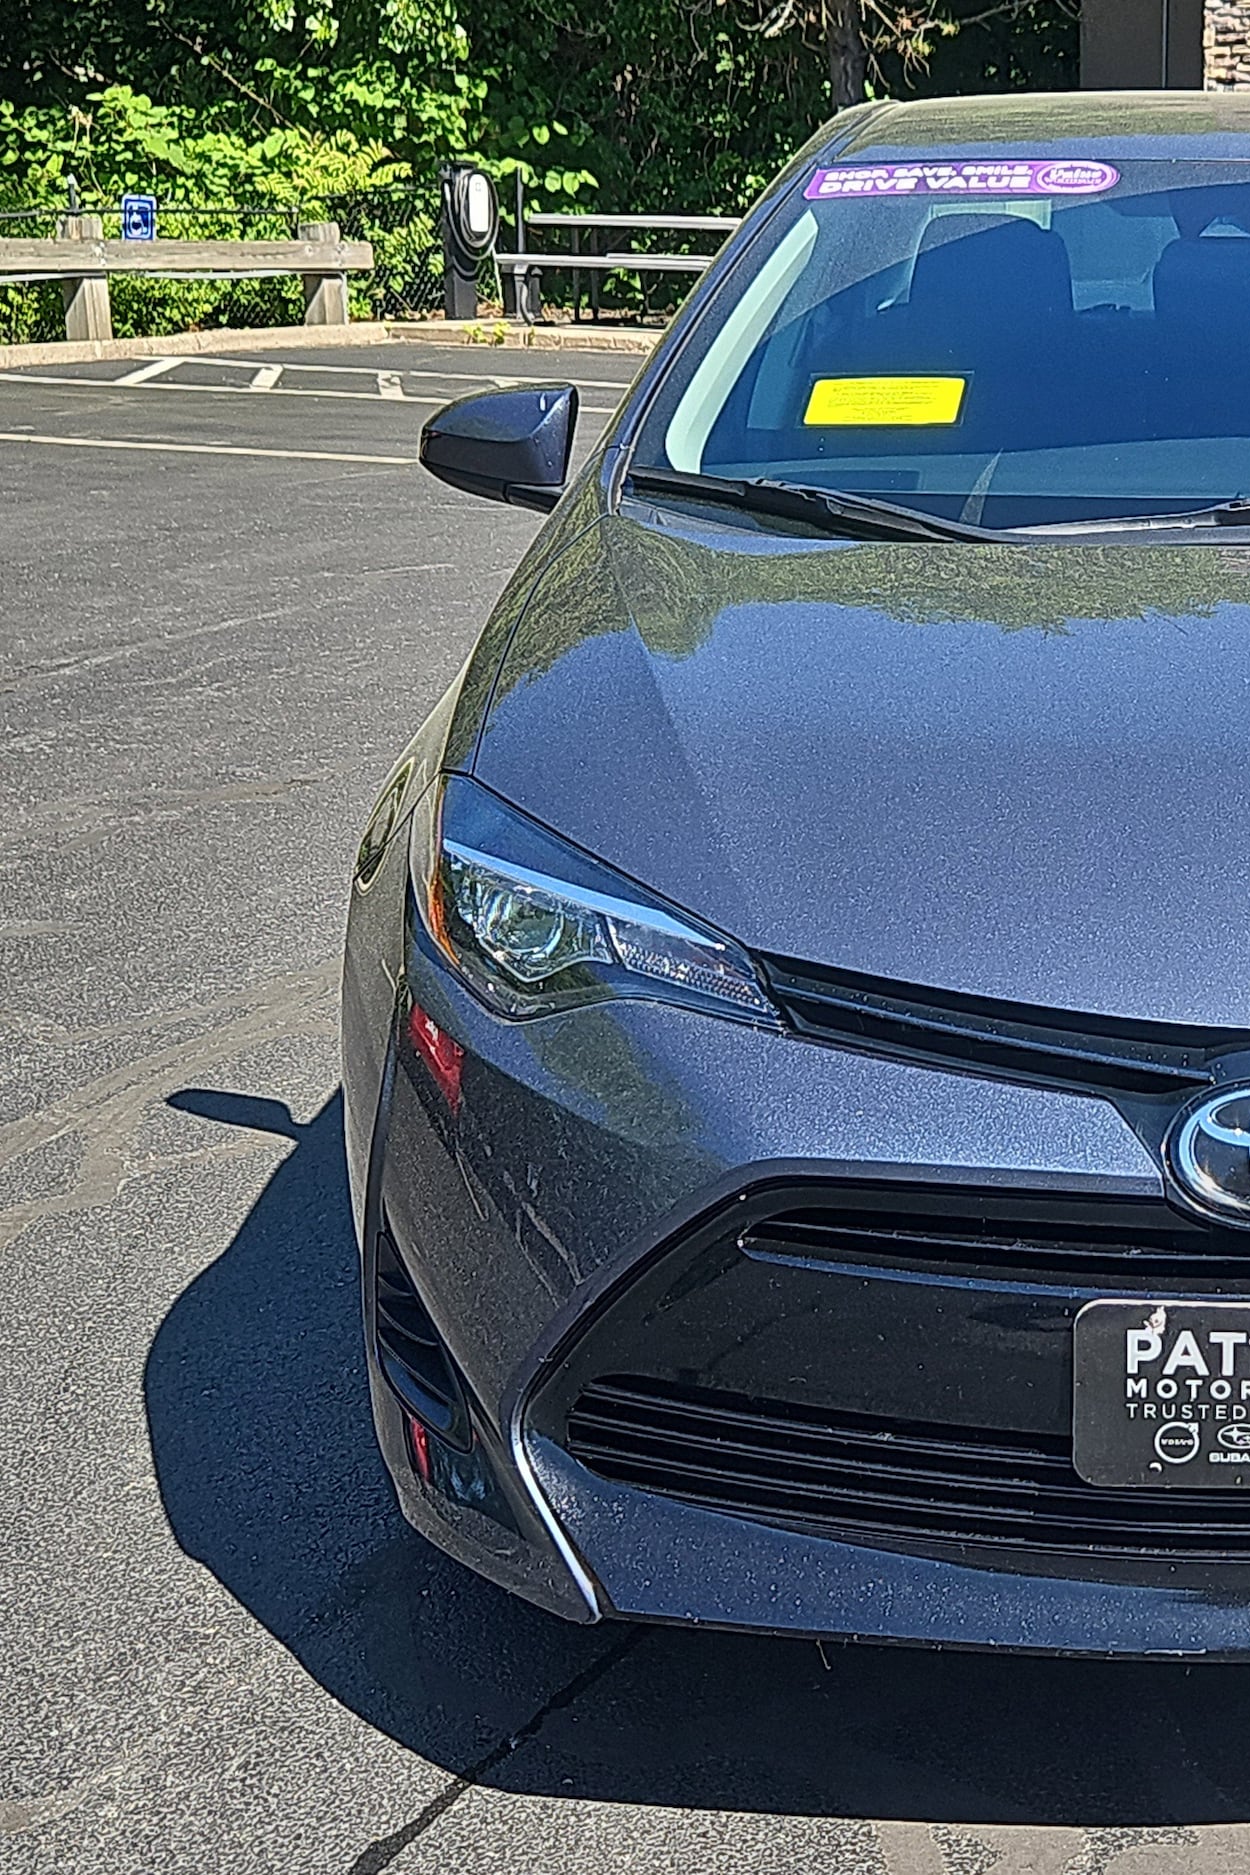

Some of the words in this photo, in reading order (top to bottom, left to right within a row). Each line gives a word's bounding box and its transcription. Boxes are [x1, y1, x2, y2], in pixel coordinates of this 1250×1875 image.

[818, 178, 918, 193] DRIVE
[926, 176, 1031, 189] VALUE
[1126, 1404, 1247, 1421] TRUSTED
[1161, 1438, 1194, 1446] VOLVO
